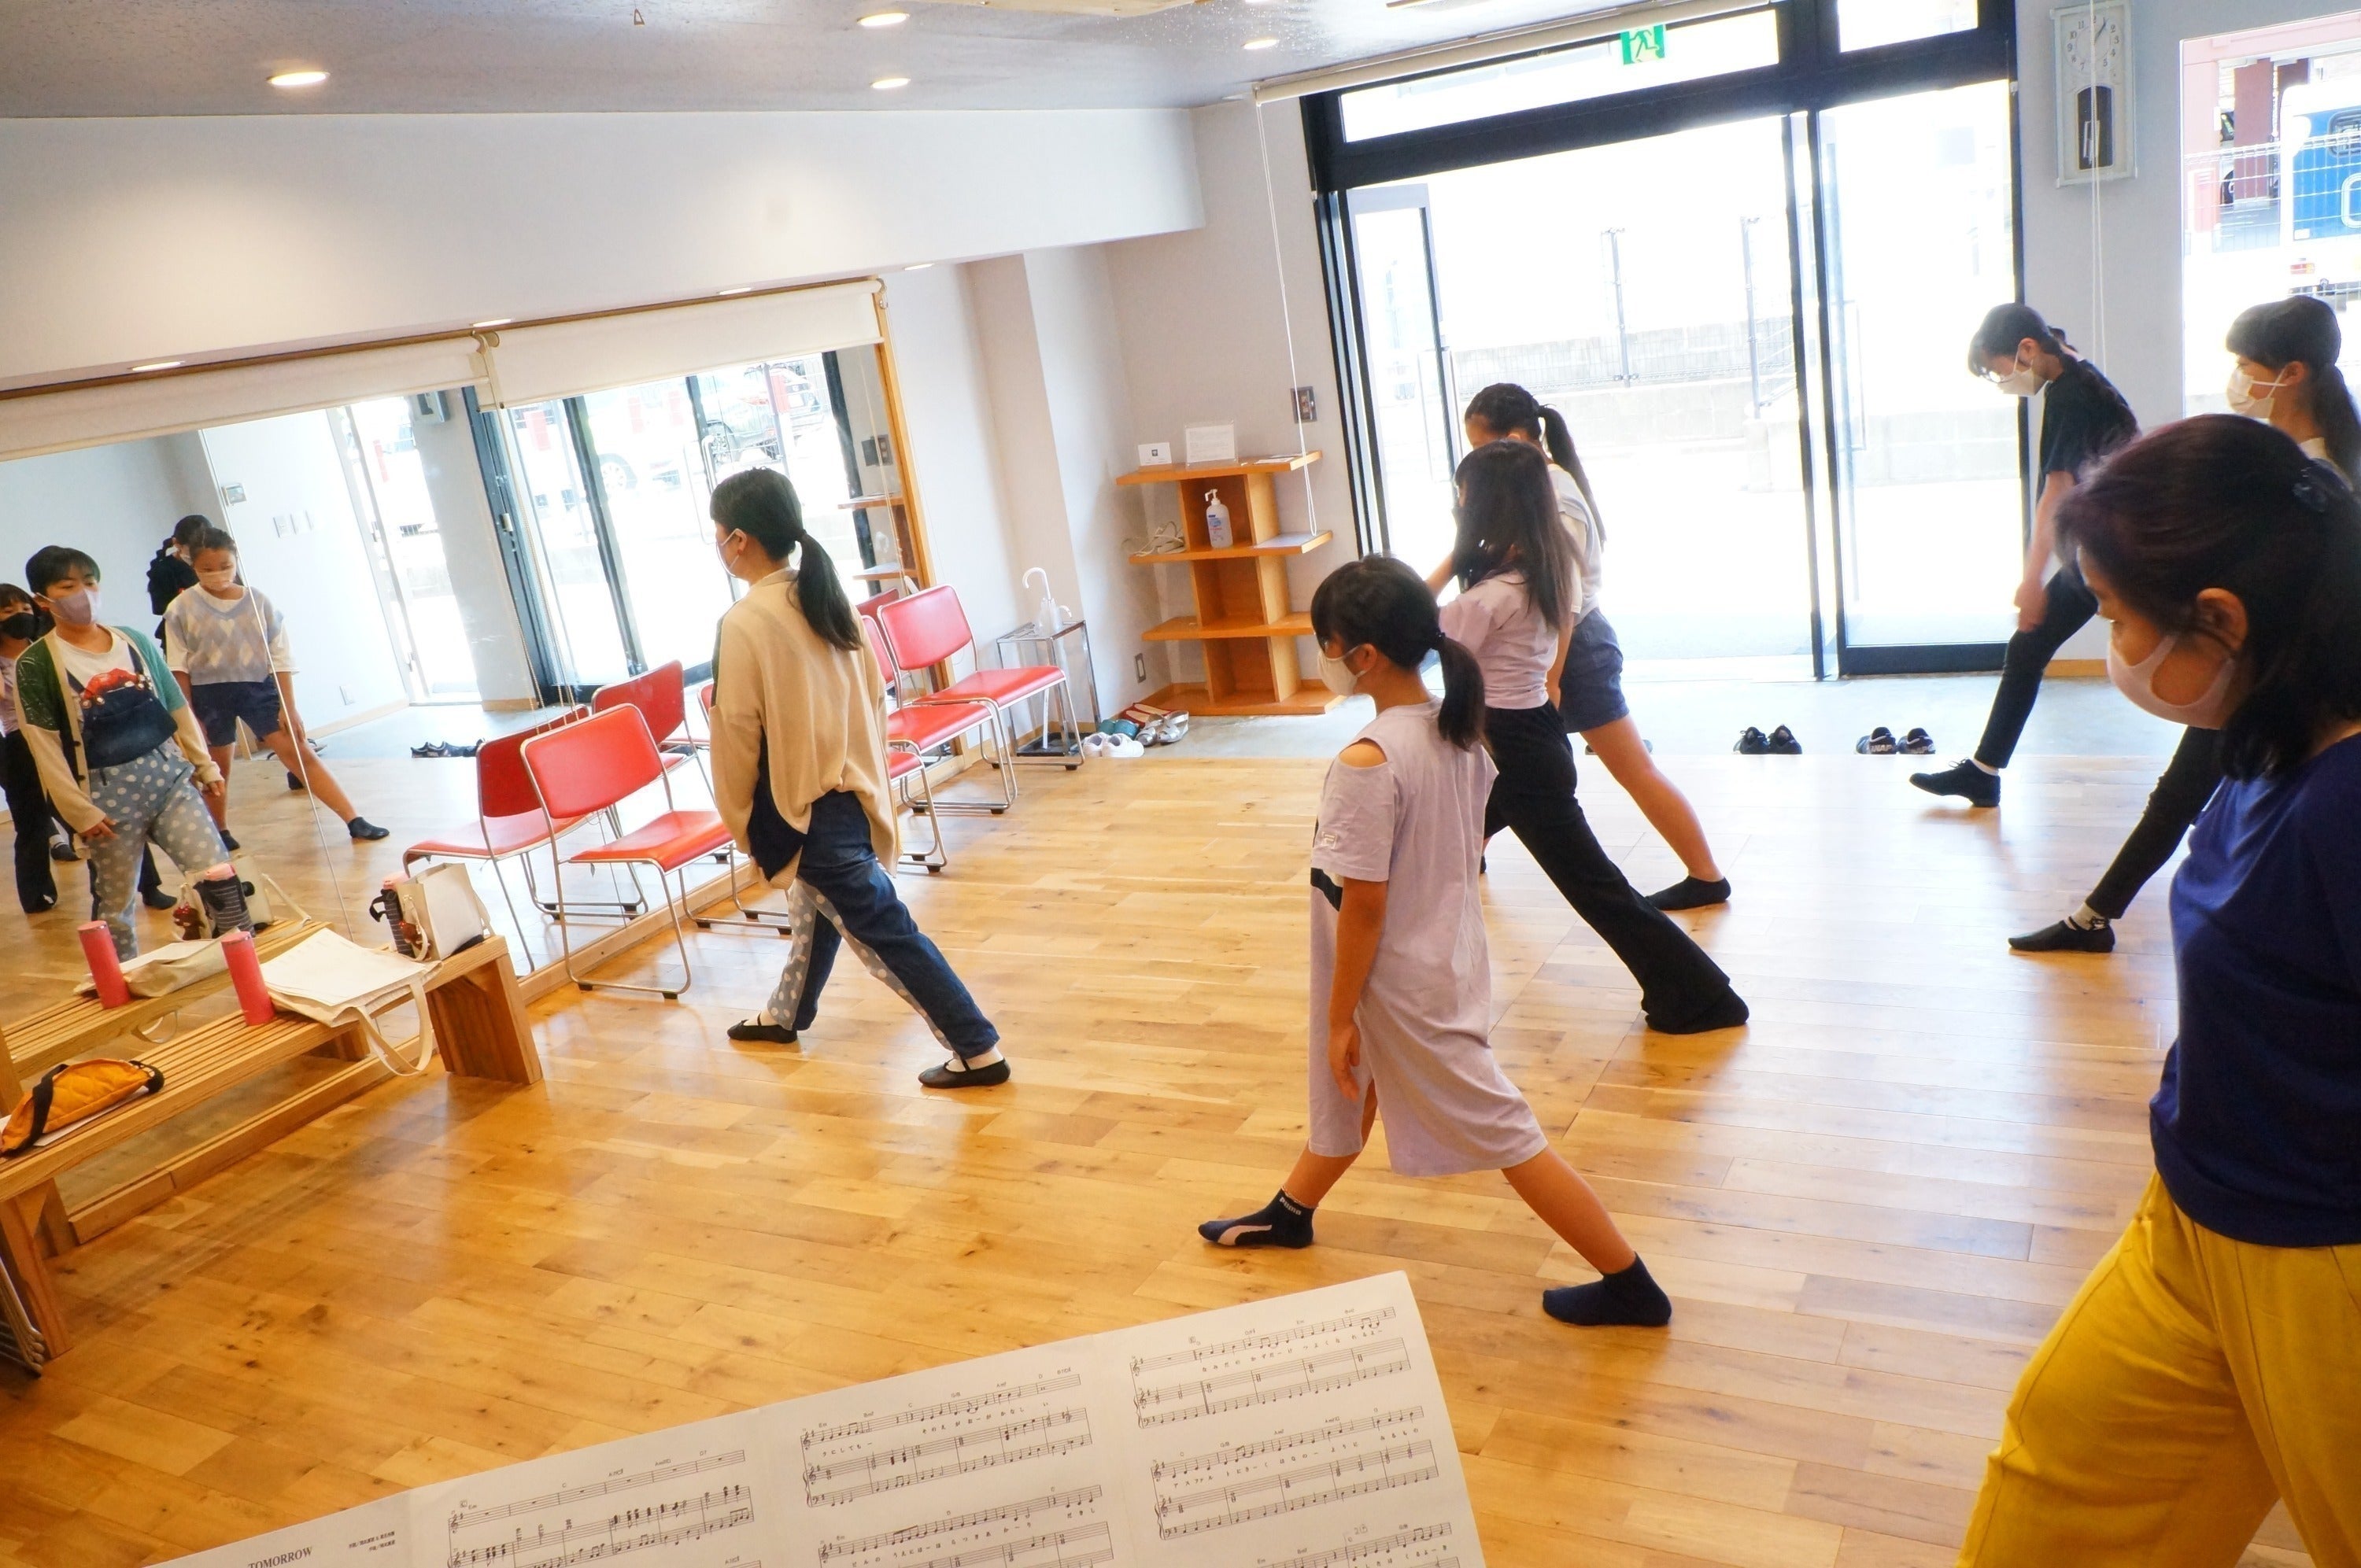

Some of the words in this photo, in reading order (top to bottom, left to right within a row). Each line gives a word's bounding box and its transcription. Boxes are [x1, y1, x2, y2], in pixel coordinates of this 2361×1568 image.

[2110, 24, 2115, 33] 2
[2113, 35, 2119, 44] 3
[2067, 42, 2073, 52] 9
[2111, 48, 2116, 57] 4
[2079, 61, 2086, 71] 7
[2102, 57, 2108, 67] 5
[248, 1547, 312, 1568] TOMORROW
